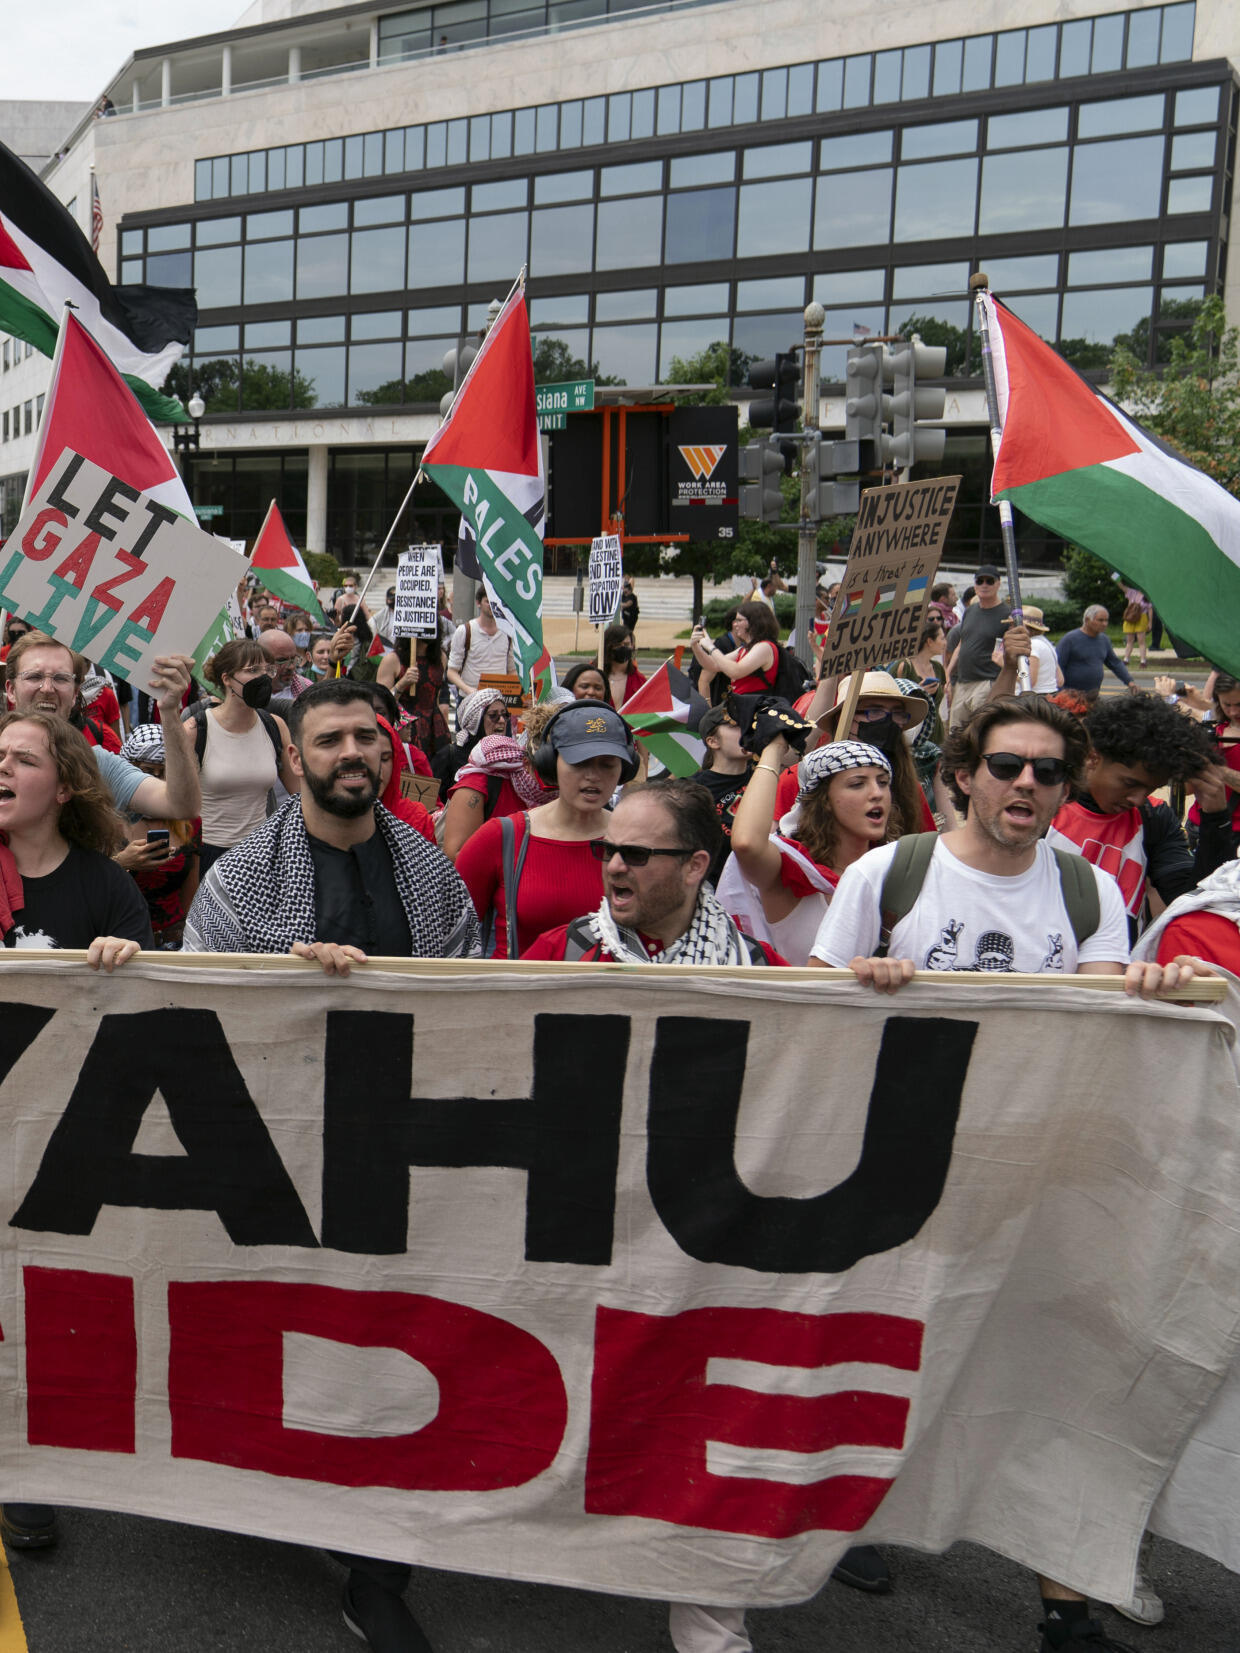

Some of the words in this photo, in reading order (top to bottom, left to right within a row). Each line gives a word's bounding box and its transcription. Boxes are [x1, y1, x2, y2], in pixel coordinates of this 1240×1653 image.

[537, 388, 567, 410] siana
[574, 384, 587, 395] AVE
[575, 396, 585, 406] NW
[46, 453, 178, 559] LET
[859, 485, 956, 530] INJUSTICE
[464, 473, 542, 602] PALES
[718, 527, 733, 538] 35
[851, 522, 941, 560] ANYWHERE
[408, 552, 424, 562] WHEN
[912, 557, 925, 576] to
[21, 507, 176, 634] GAZA
[398, 565, 419, 576] PEOPLE
[421, 565, 435, 576] ARE
[604, 562, 620, 578] THE
[399, 580, 432, 592] OCCUPIED,
[396, 596, 436, 608] RESISTANCE
[395, 610, 402, 622] IS
[403, 611, 435, 623] JUSTIFIED
[832, 605, 922, 651] JUSTICE
[820, 637, 917, 677] EVERYWHERE
